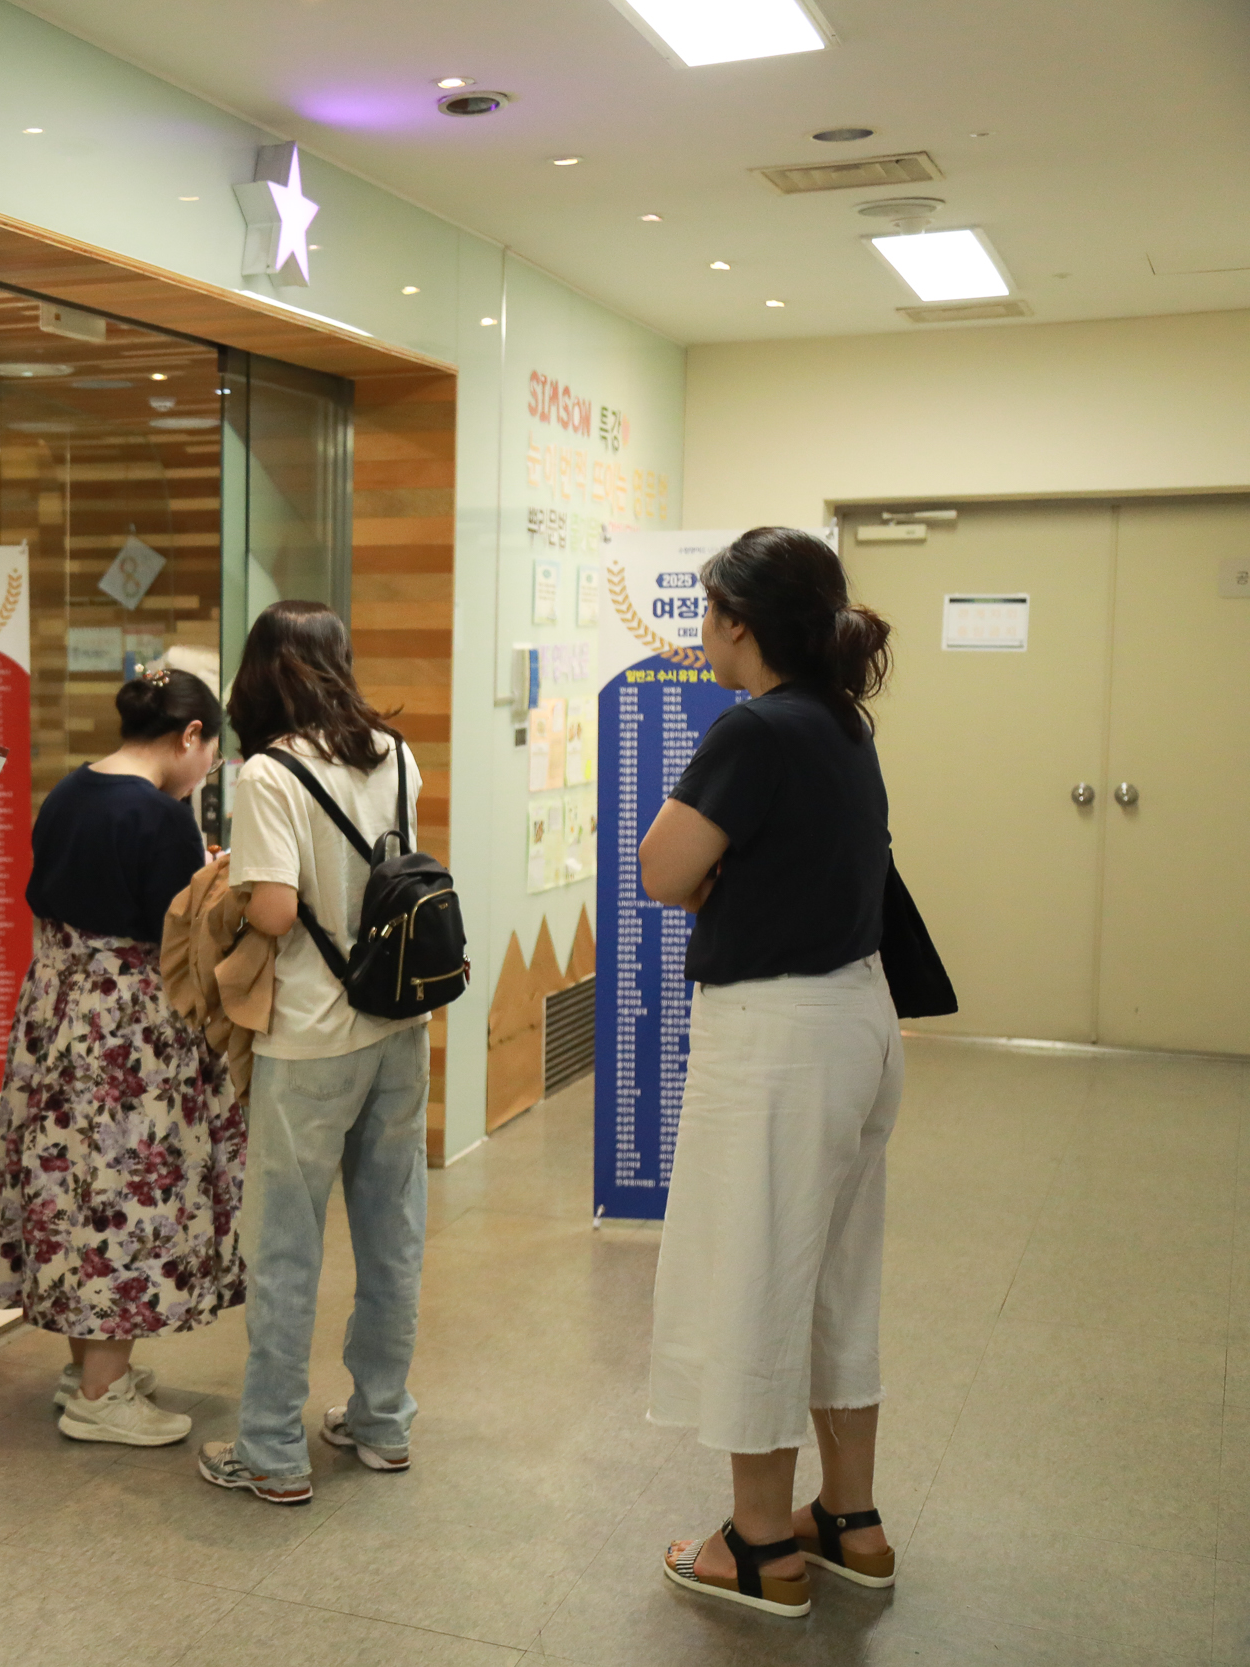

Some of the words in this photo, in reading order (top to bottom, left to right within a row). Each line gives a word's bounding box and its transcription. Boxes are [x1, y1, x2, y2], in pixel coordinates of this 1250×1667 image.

[528, 370, 592, 438] SIMSON
[662, 574, 692, 587] 2025
[678, 627, 698, 637] 대입
[657, 670, 676, 682] 수시
